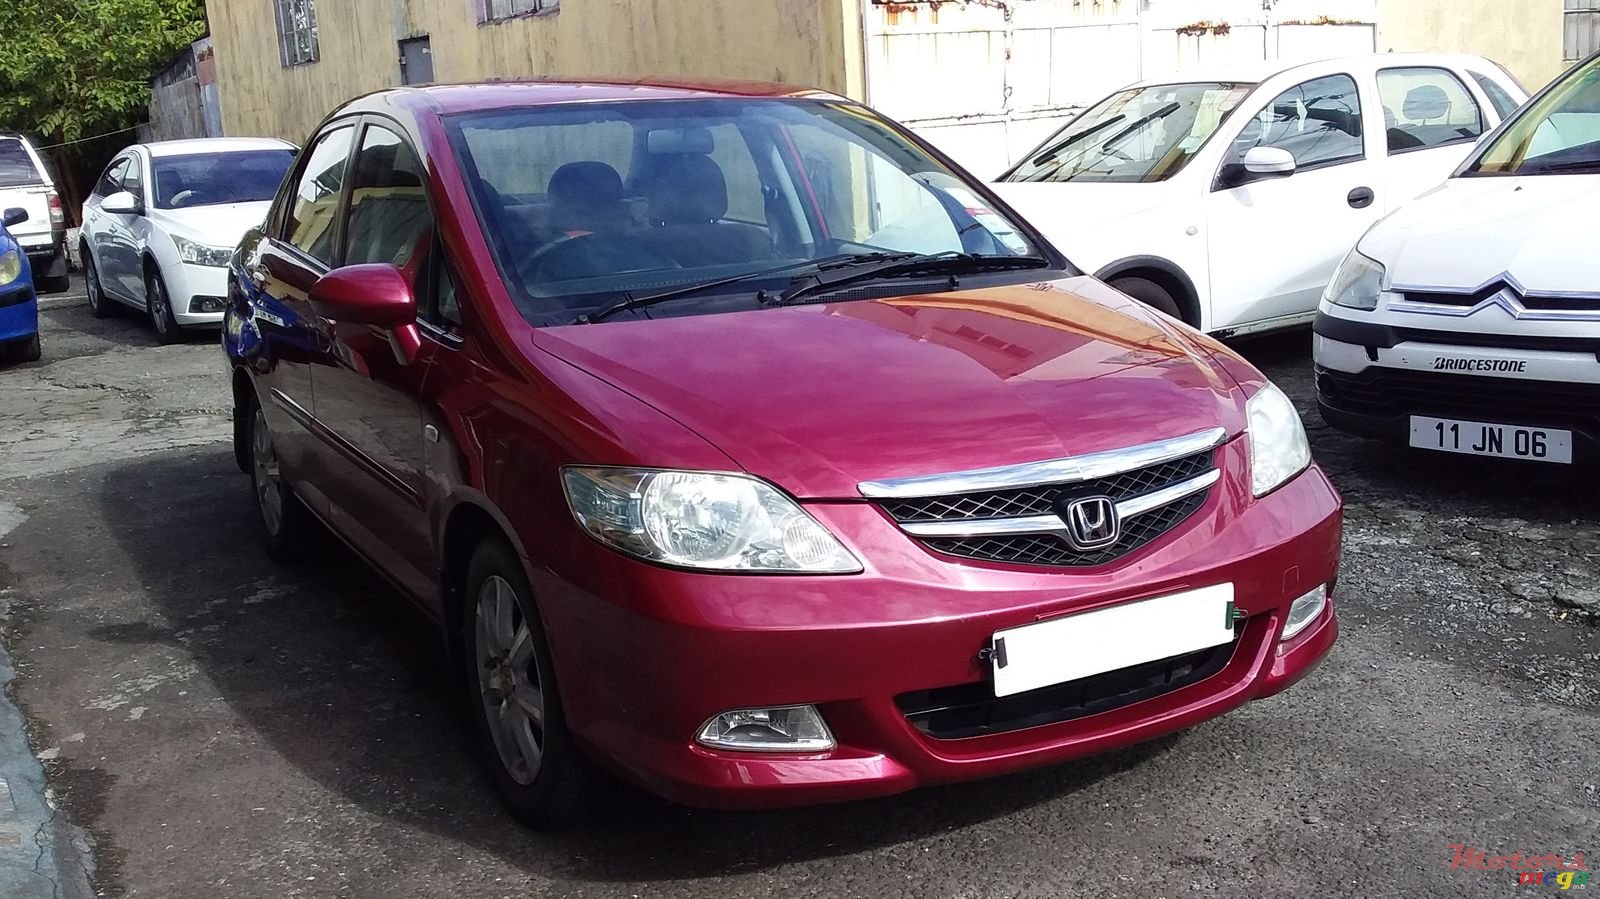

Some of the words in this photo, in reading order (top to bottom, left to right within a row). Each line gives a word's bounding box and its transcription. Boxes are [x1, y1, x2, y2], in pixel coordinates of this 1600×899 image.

[1434, 357, 1527, 372] BRIDGESTONE
[1435, 422, 1459, 449] 11
[1472, 426, 1503, 453] JN
[1514, 430, 1547, 457] 06
